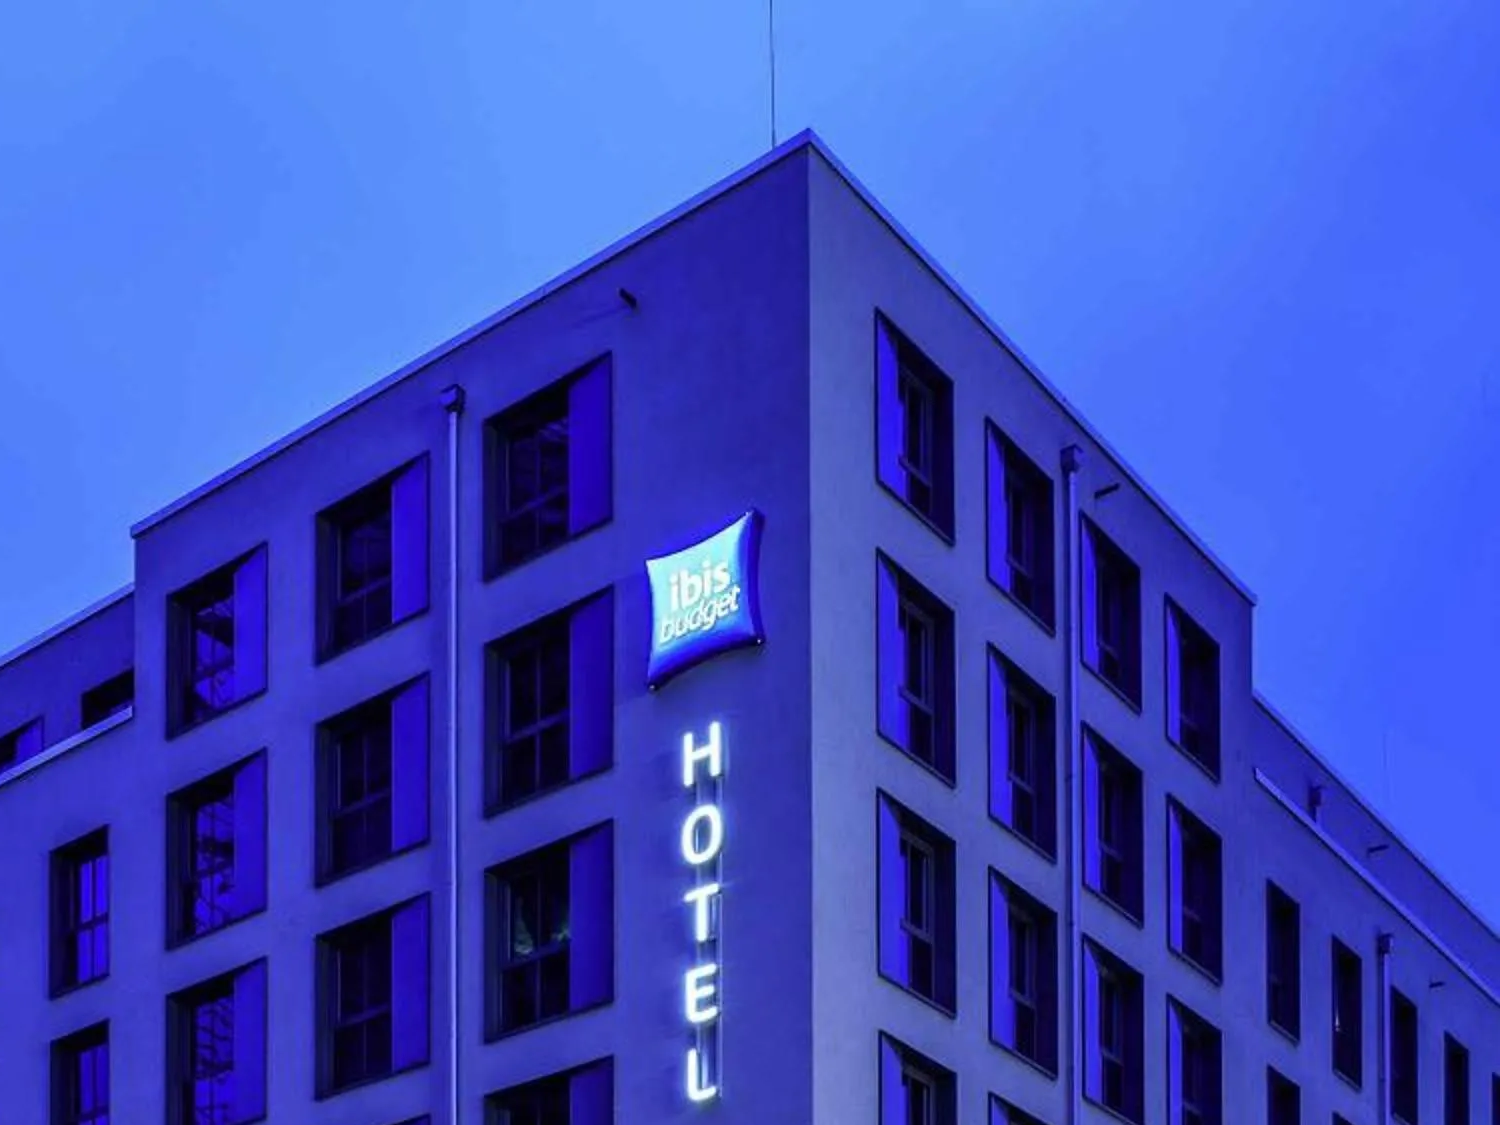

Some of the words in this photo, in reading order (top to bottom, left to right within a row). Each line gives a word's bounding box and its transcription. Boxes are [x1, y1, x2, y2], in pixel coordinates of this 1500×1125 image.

[659, 585, 741, 644] budget
[670, 560, 731, 612] ibis
[681, 721, 722, 1101] HOTEL
